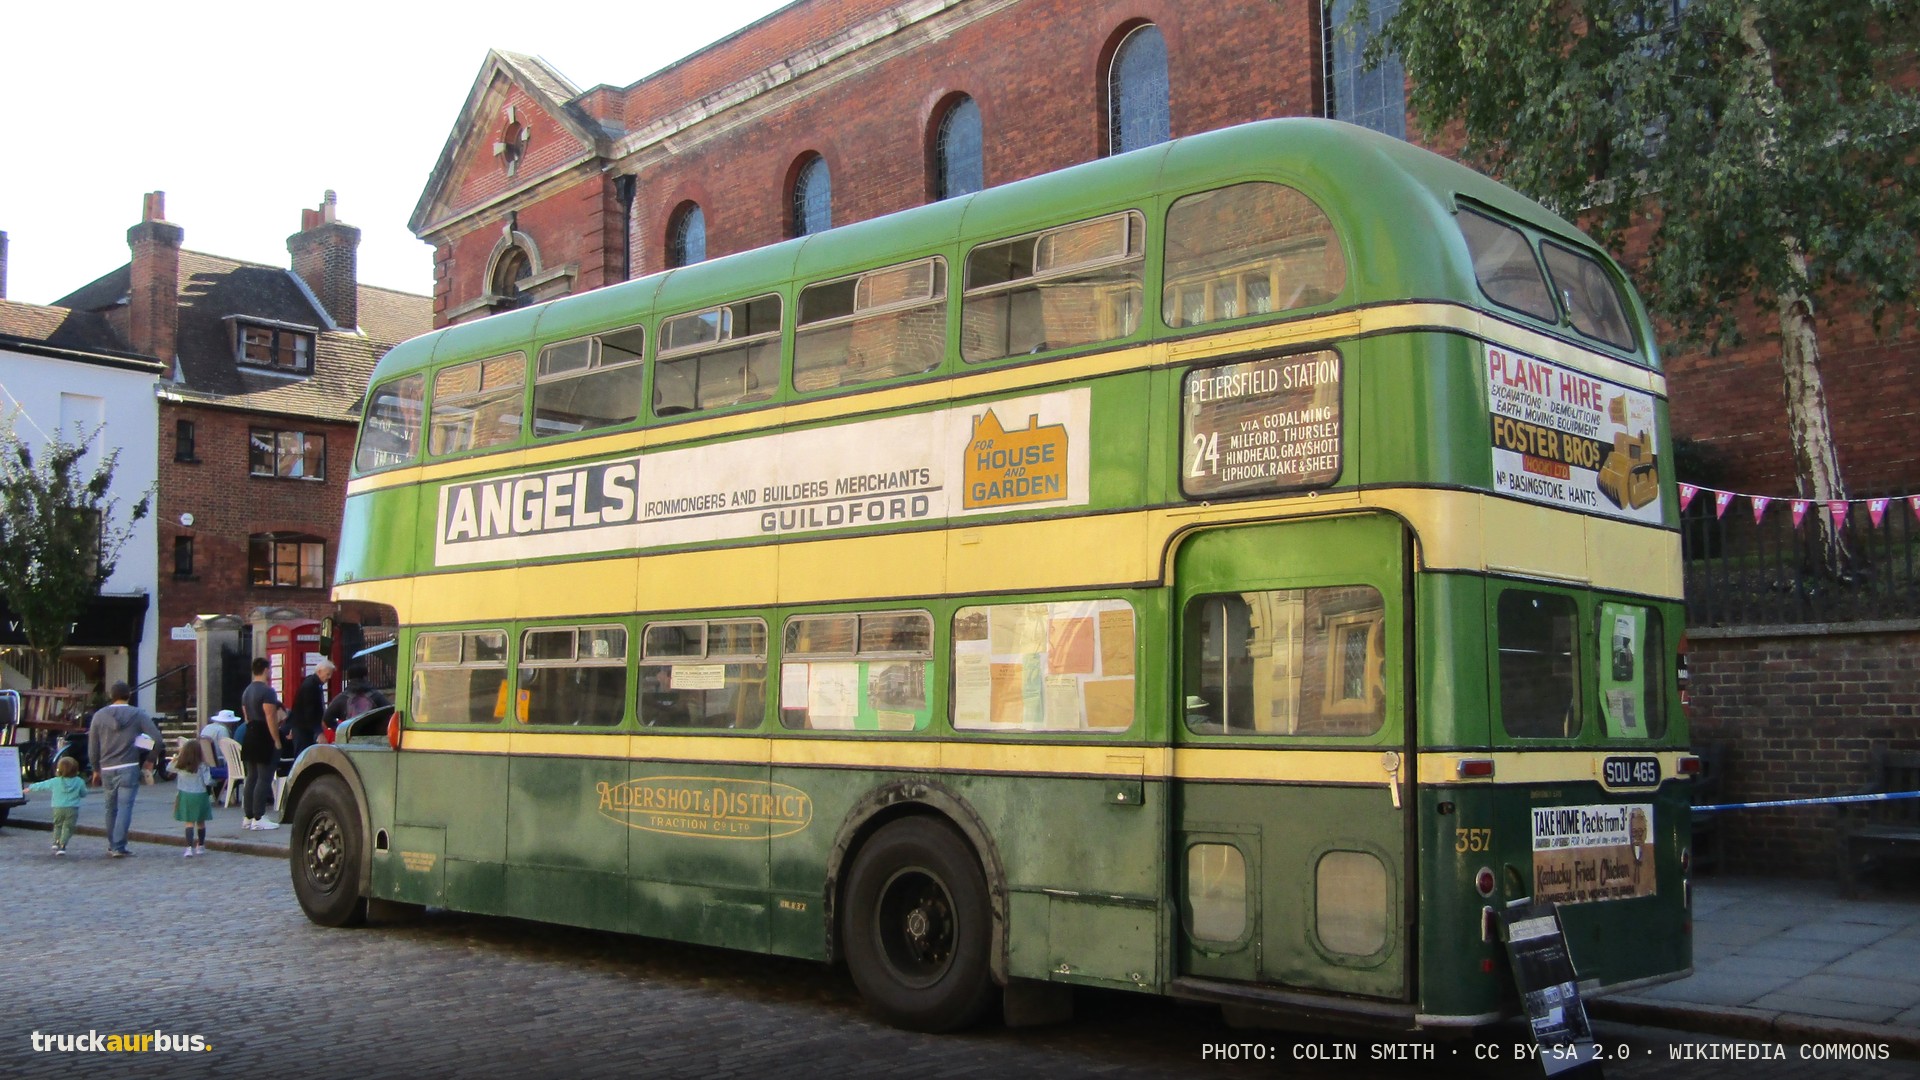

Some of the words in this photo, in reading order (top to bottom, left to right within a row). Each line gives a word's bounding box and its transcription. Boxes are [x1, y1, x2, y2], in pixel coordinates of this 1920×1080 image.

[1191, 368, 1278, 402] PETERSFIELD
[1283, 359, 1339, 389] STATION
[1489, 349, 1553, 397] PLANT
[1559, 372, 1604, 413] HIRE
[1240, 420, 1260, 432] VIA
[1263, 406, 1331, 428] GODALMING
[1491, 385, 1542, 409] EXCAVATIONS
[1550, 401, 1601, 425] DEMOLITIONS
[1496, 400, 1522, 418] EARTH
[1525, 407, 1554, 426] MOVING
[1557, 417, 1599, 437] EQUIPMENT
[974, 439, 994, 451] FOR
[1283, 422, 1339, 442] THURSLEY
[1493, 416, 1559, 460] FOSTER
[977, 443, 1055, 471] HOUSE
[1190, 431, 1220, 478] 24
[1281, 438, 1339, 458] GRAYSHOTT
[1003, 466, 1026, 479] AND
[1269, 460, 1297, 475] RAKE
[1298, 460, 1305, 472] &
[1306, 454, 1339, 472] SHEET
[645, 493, 726, 517] IRONMONGERS
[731, 489, 756, 505] AND
[763, 480, 828, 502] BUILDERS
[835, 468, 930, 495] MERCHANTS
[972, 474, 1060, 501] GARDEN
[446, 464, 637, 541] ANGELS
[761, 495, 929, 532] GUILDFORD
[1606, 762, 1630, 783] SOU
[1633, 761, 1656, 782] 465
[596, 782, 703, 811] ALDERSHOT
[703, 798, 711, 812] &
[713, 788, 807, 819] DISTRICT
[650, 816, 707, 830] TRACTION
[1534, 810, 1555, 836] TAKE
[1555, 809, 1580, 836] HOME
[1581, 810, 1604, 834] Packs
[1604, 812, 1619, 832] from
[1455, 828, 1492, 853] 357
[1536, 863, 1571, 892] Kentucky
[1574, 859, 1596, 889] Fried
[1600, 857, 1630, 886] Chicken
